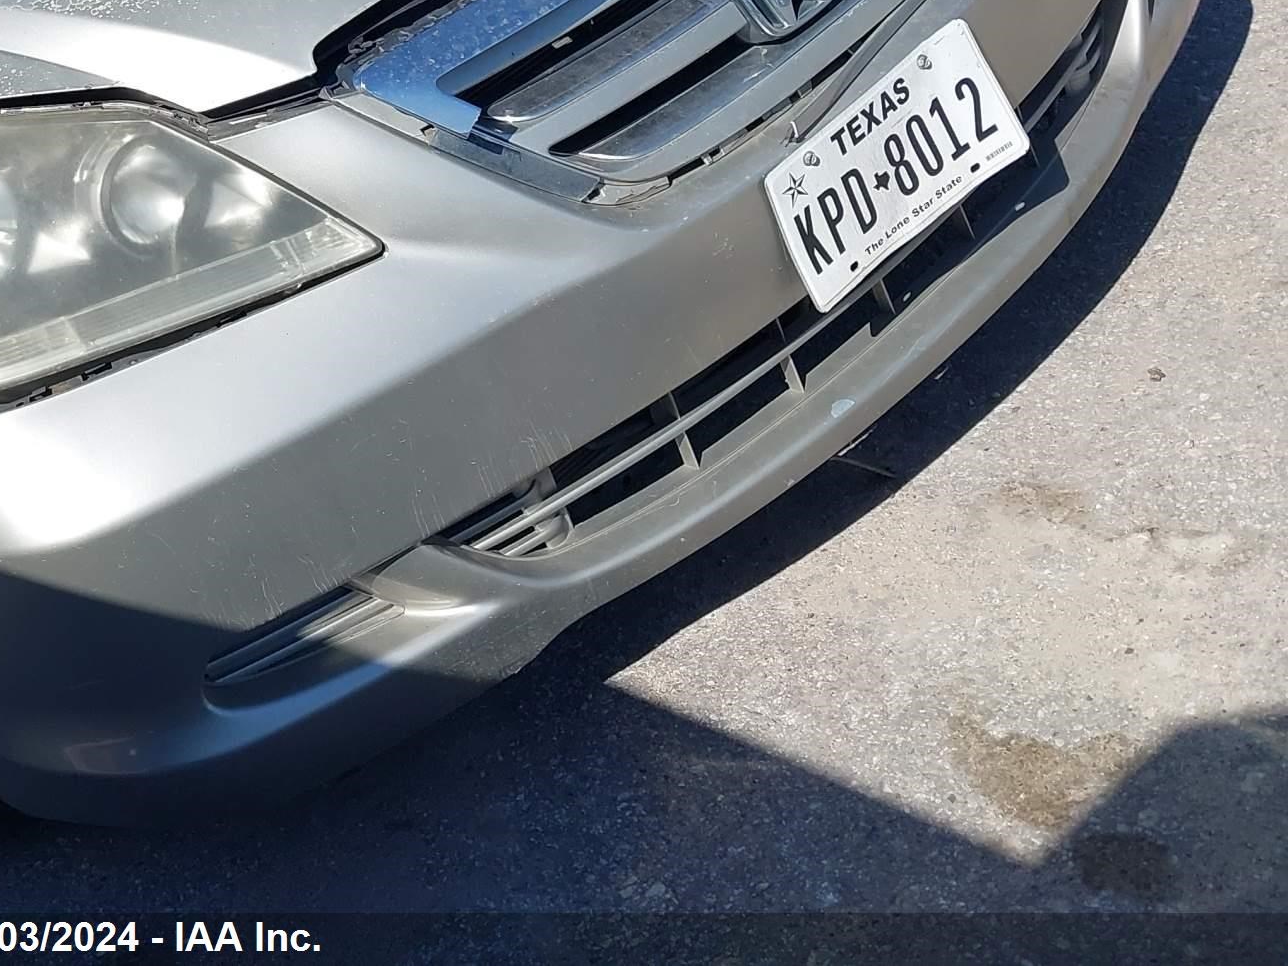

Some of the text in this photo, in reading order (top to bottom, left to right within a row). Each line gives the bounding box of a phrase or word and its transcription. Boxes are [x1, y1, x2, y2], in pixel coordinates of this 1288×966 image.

[830, 77, 910, 156] TEXAS
[864, 175, 963, 256] The Lone Star State
